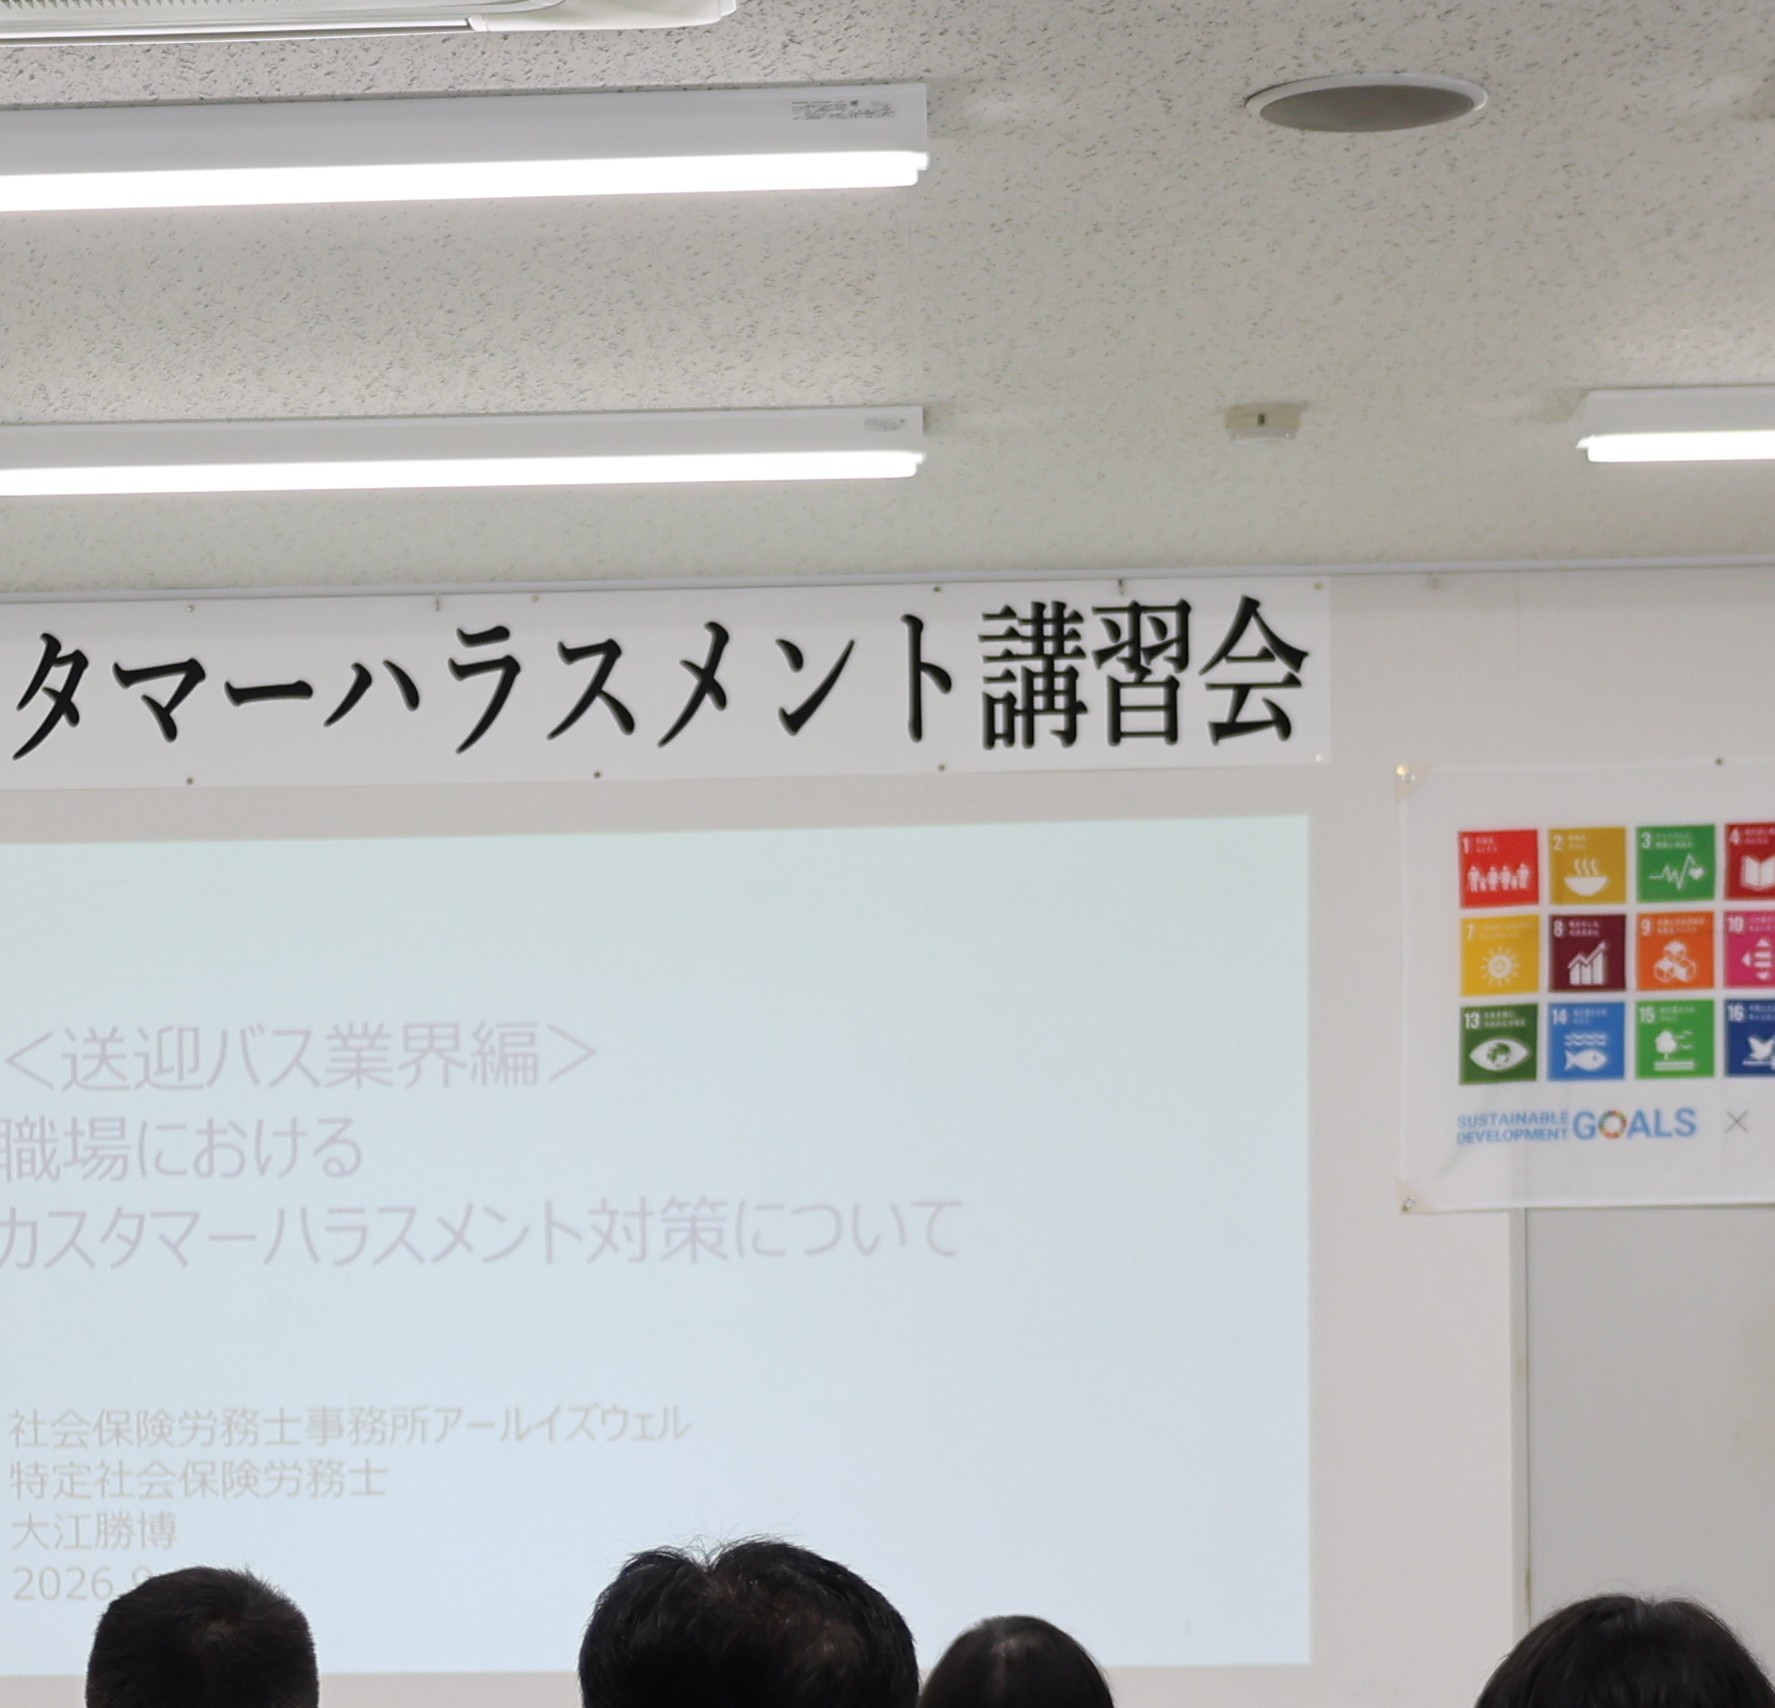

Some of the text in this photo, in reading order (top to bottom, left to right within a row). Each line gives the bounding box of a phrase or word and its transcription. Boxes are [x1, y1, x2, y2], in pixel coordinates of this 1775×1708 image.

[1462, 838, 1469, 853] 1
[1553, 835, 1563, 851] 2
[1641, 833, 1652, 849] 3
[1729, 829, 1741, 845] 4
[1466, 925, 1475, 941] 7
[1553, 920, 1565, 937] 8
[1641, 919, 1653, 936] 9
[1727, 916, 1745, 933] 10
[1552, 1009, 1568, 1025] 14
[1638, 1007, 1656, 1024] 15
[1727, 1004, 1745, 1021] 16
[1464, 1013, 1481, 1030] 13
[1456, 1111, 1569, 1129] SUSTAINABLE
[1572, 1107, 1698, 1141] GOALS
[1456, 1128, 1568, 1145] DEVELOPMENT
[7, 1404, 694, 1450] 社会保険労務士事務所アールイズウェル
[9, 1458, 390, 1501] 特定社会保険労務士
[10, 1511, 179, 1553] 大江勝博
